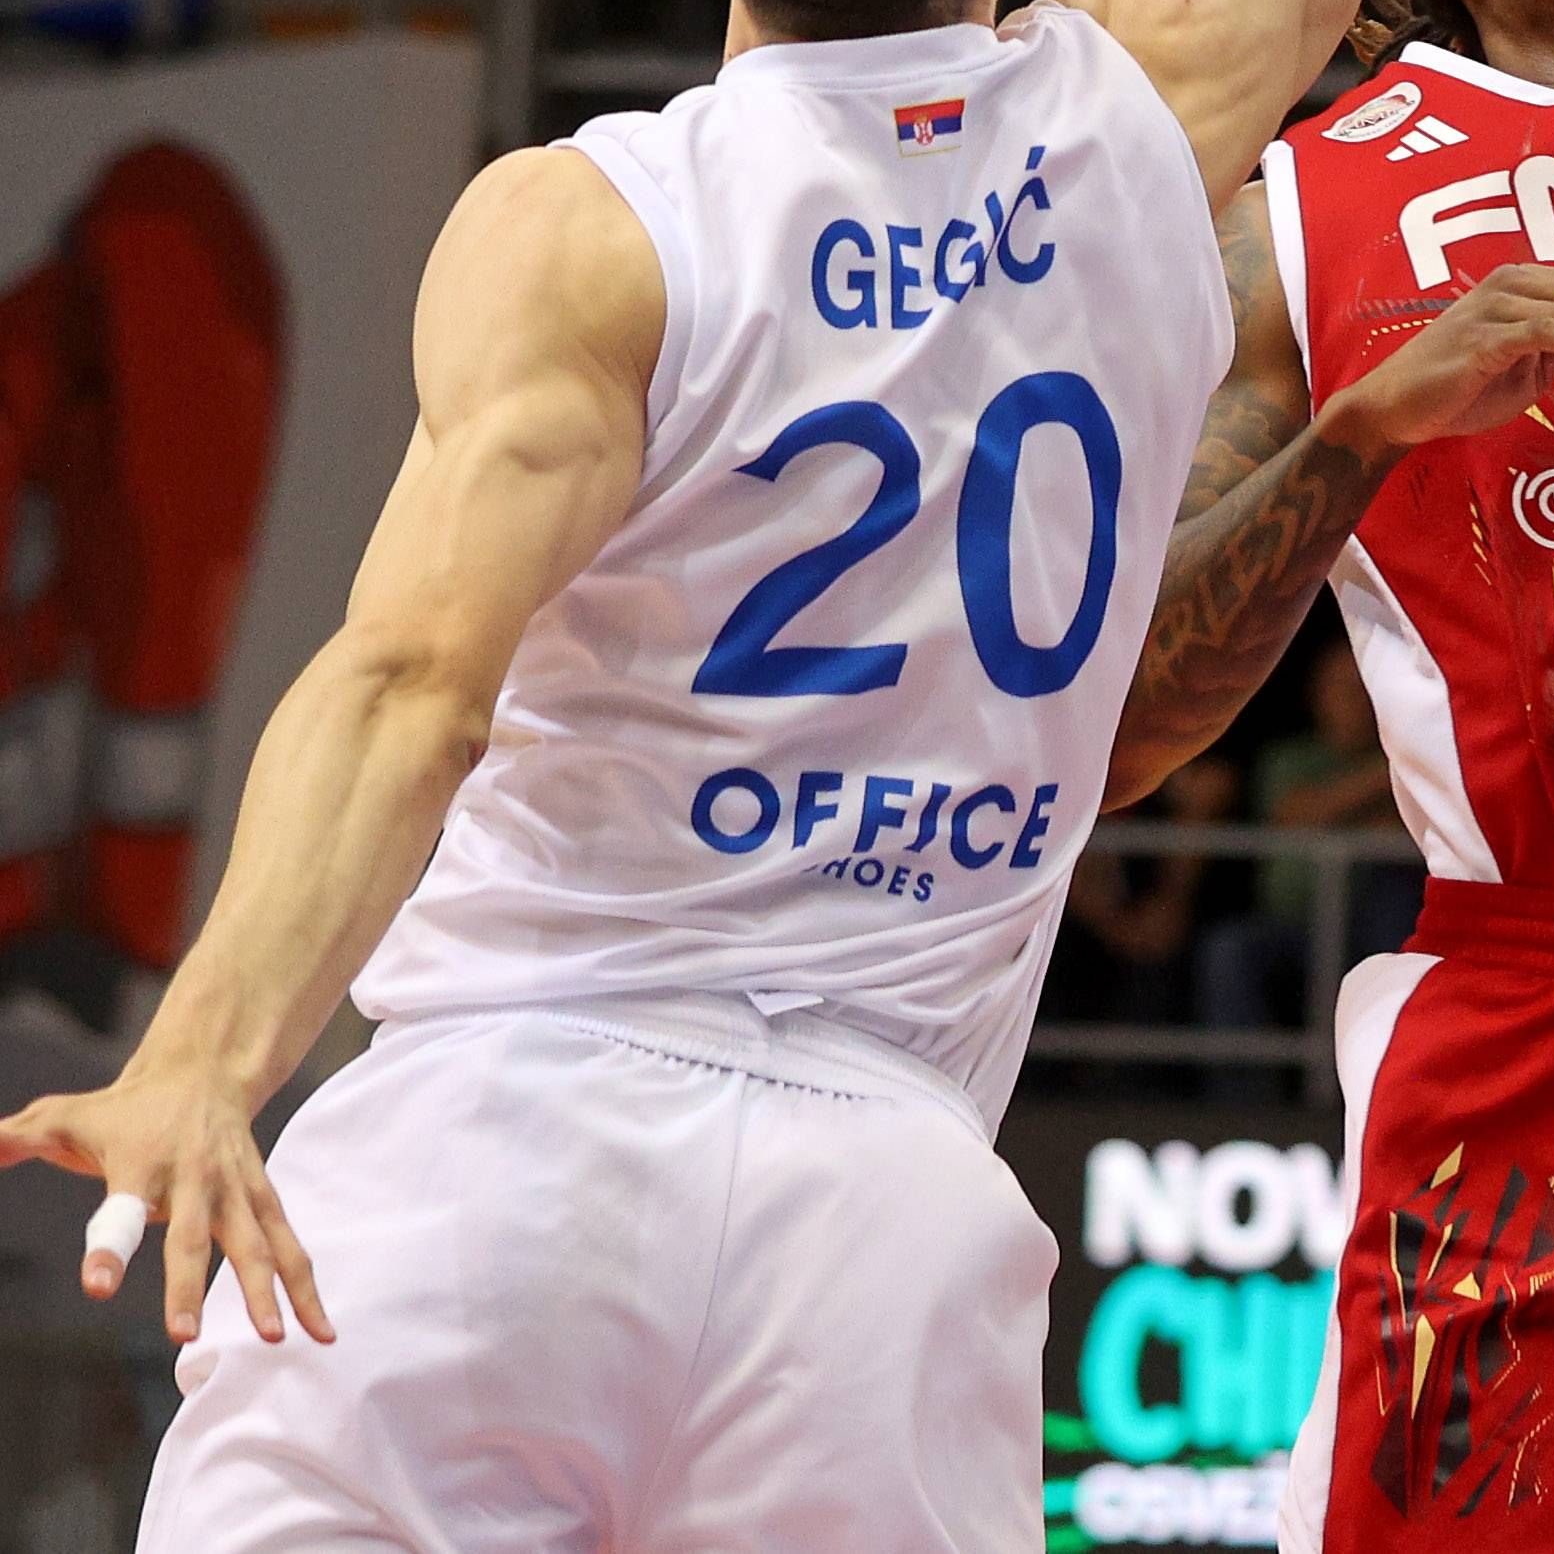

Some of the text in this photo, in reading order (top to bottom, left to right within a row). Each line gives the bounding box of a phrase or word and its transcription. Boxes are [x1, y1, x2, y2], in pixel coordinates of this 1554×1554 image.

[811, 146, 1056, 330] GEGIĆ
[691, 371, 1123, 698] 20
[691, 767, 1059, 870] OFFICE
[803, 856, 934, 902] HOES
